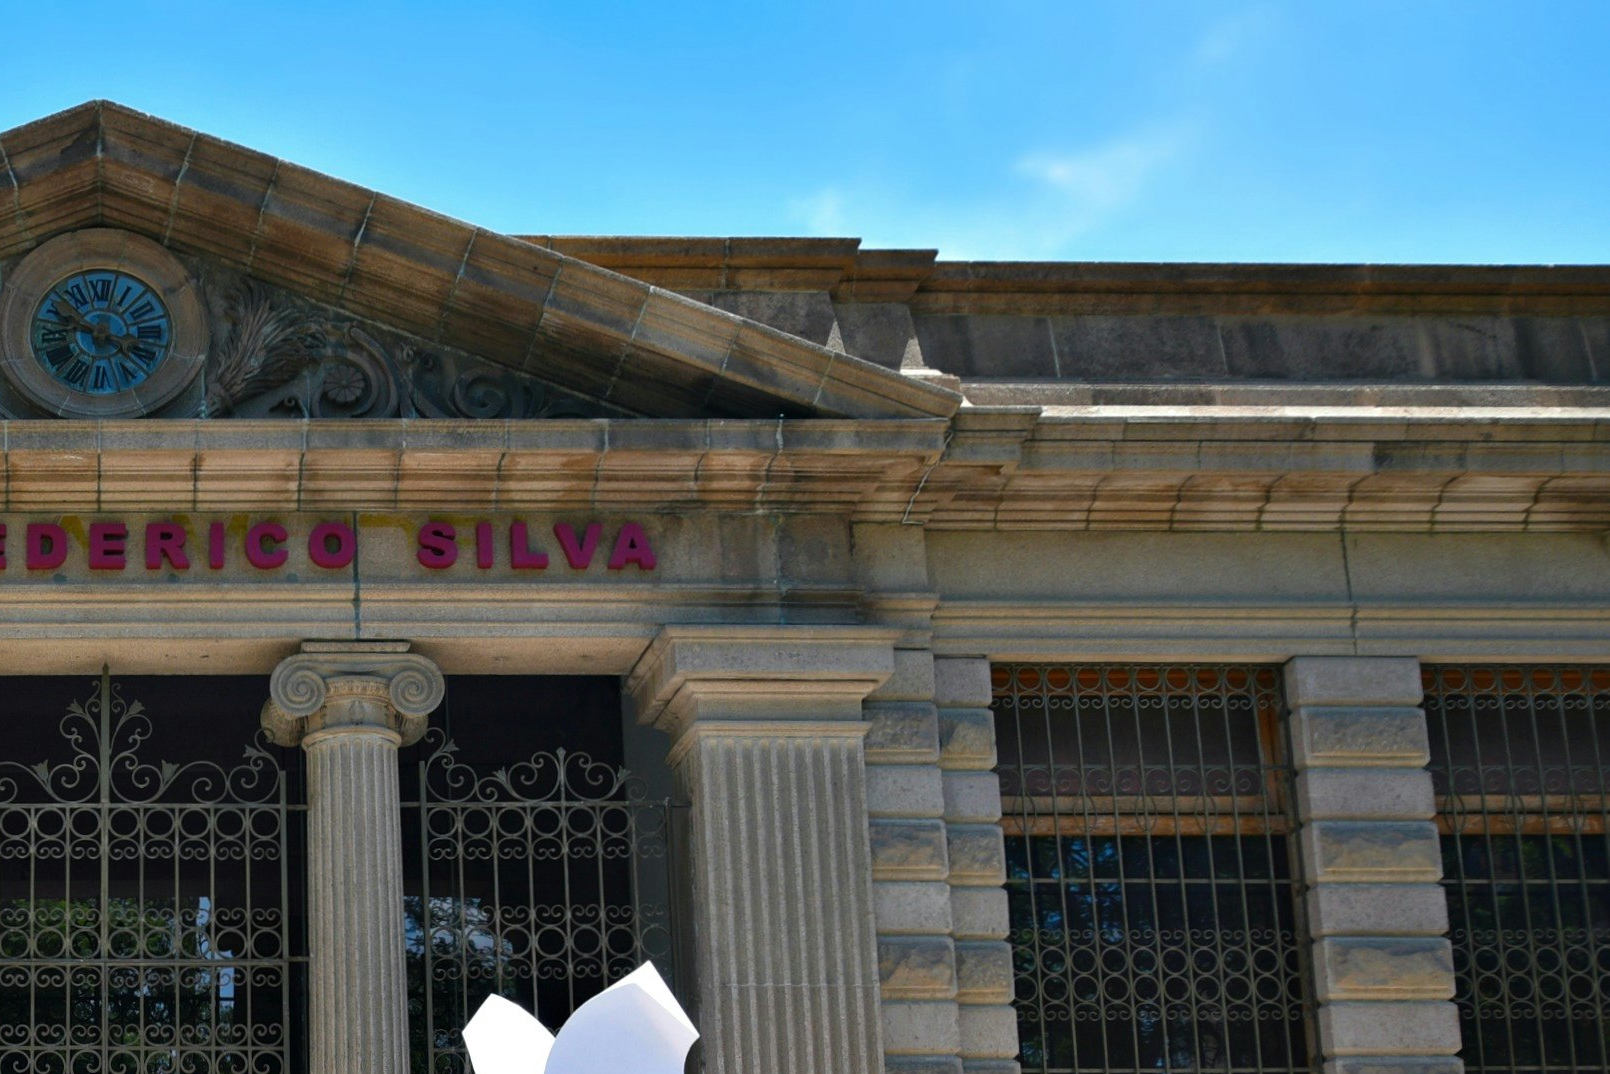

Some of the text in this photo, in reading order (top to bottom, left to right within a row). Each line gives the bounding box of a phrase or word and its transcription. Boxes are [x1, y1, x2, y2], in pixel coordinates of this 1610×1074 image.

[65, 283, 89, 309] XI
[88, 279, 112, 302] XII
[117, 286, 132, 307] I
[129, 300, 156, 320] II
[137, 325, 162, 339] III
[93, 365, 112, 389] VI
[119, 361, 138, 383] V
[416, 520, 658, 571] SILVA
